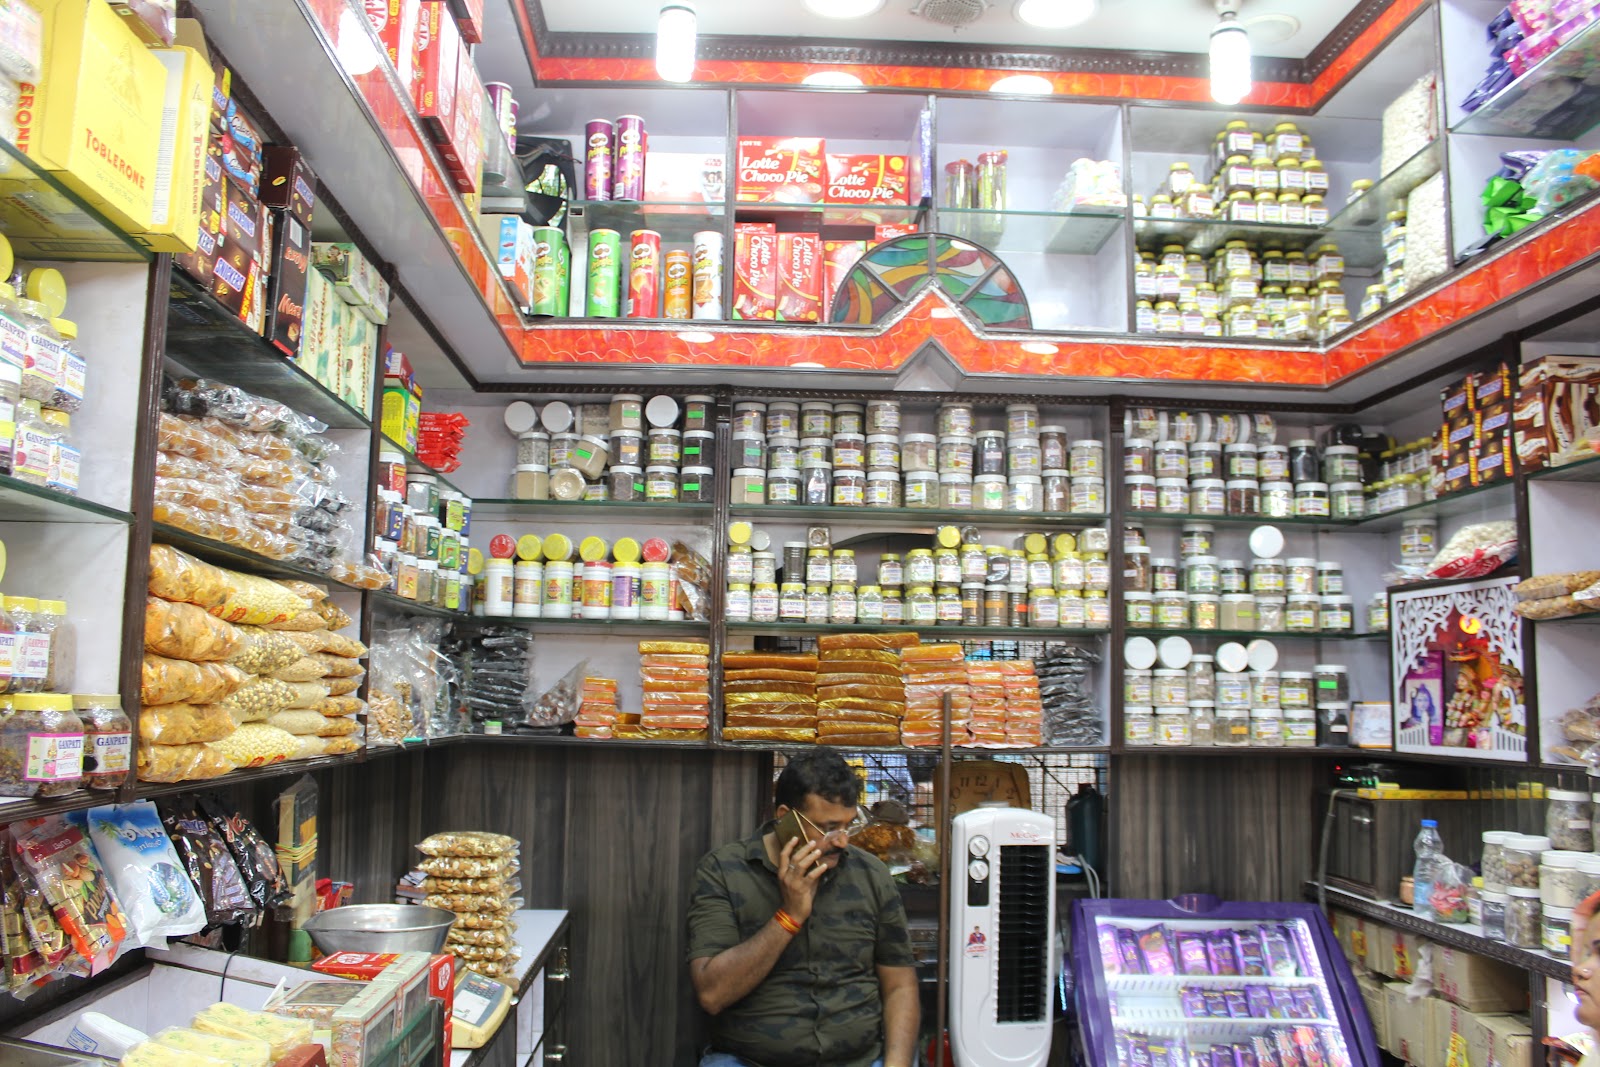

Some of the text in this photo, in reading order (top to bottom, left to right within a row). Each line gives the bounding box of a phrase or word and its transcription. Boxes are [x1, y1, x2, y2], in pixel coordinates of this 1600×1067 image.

[15, 82, 36, 153] ERONE
[85, 128, 146, 190] TOBLERONE
[741, 157, 780, 170] Lotte
[192, 134, 203, 215] TOBLERONE
[741, 170, 808, 183] Choco Pie
[829, 175, 866, 186] Lotte
[828, 186, 894, 199] Choco Pie
[761, 236, 773, 265] Lotte
[802, 237, 813, 266] Lotte
[750, 236, 761, 287] Choco Pie
[792, 237, 803, 288] Choco Pie
[214, 259, 245, 291] SNICKERS
[31, 335, 60, 354] GANPATI
[58, 740, 81, 749] GANPATI
[97, 736, 128, 747] GANPATI
[960, 776, 970, 788] 11
[975, 775, 988, 787] 12
[1010, 832, 1040, 842] McCoy
